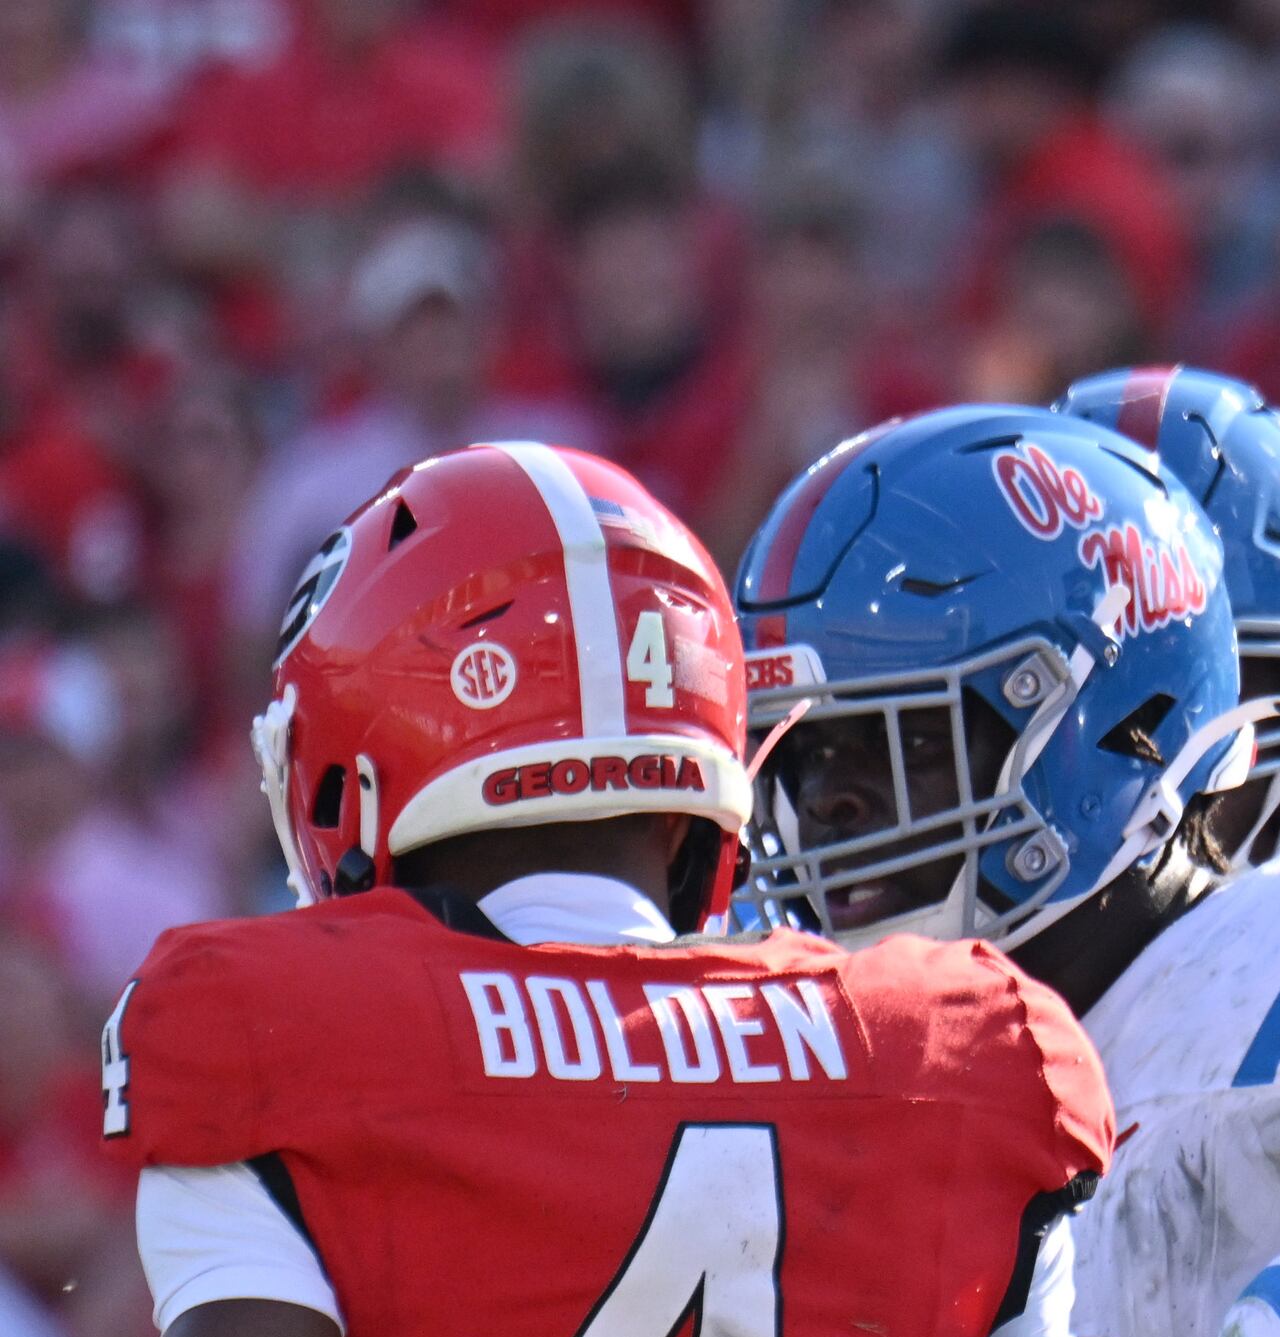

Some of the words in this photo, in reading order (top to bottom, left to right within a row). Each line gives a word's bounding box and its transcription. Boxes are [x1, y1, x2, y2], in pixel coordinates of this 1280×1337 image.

[993, 441, 1104, 541] Ole
[1079, 521, 1206, 645] Miss
[457, 649, 510, 701] SEC
[627, 611, 674, 708] 4
[482, 754, 706, 806] GEORGIA
[460, 970, 848, 1084] BOLDEN
